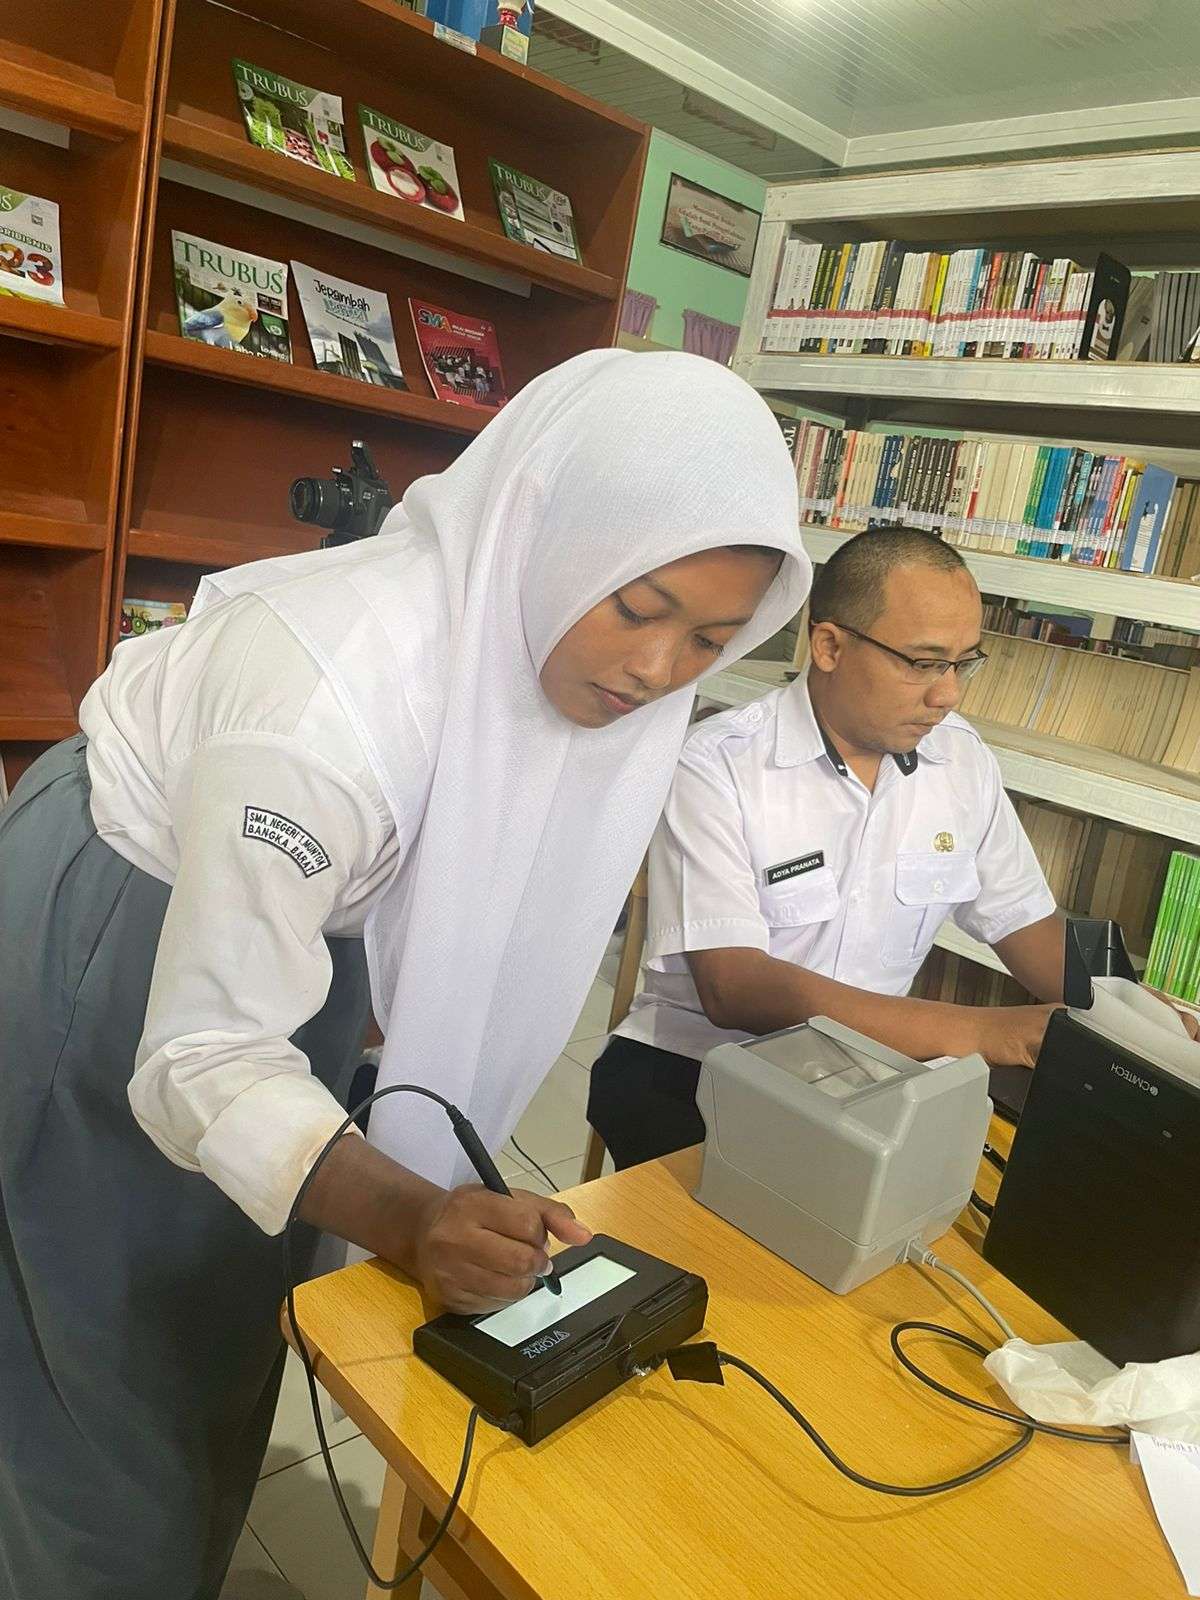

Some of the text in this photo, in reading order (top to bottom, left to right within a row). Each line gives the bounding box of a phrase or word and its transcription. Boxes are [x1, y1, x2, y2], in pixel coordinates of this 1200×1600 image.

[237, 64, 309, 107] TRUBUS
[363, 110, 426, 152] TRUBUS
[176, 238, 284, 295] TRUBUS
[247, 824, 315, 872] BANGKA BARAT
[249, 812, 267, 826] SMA
[269, 818, 301, 840] NEGERI
[302, 839, 327, 869] MUNTOK
[790, 858, 820, 873] PRANATA
[1110, 1062, 1151, 1092] CMITECH
[521, 1335, 560, 1359] TOPAZ
